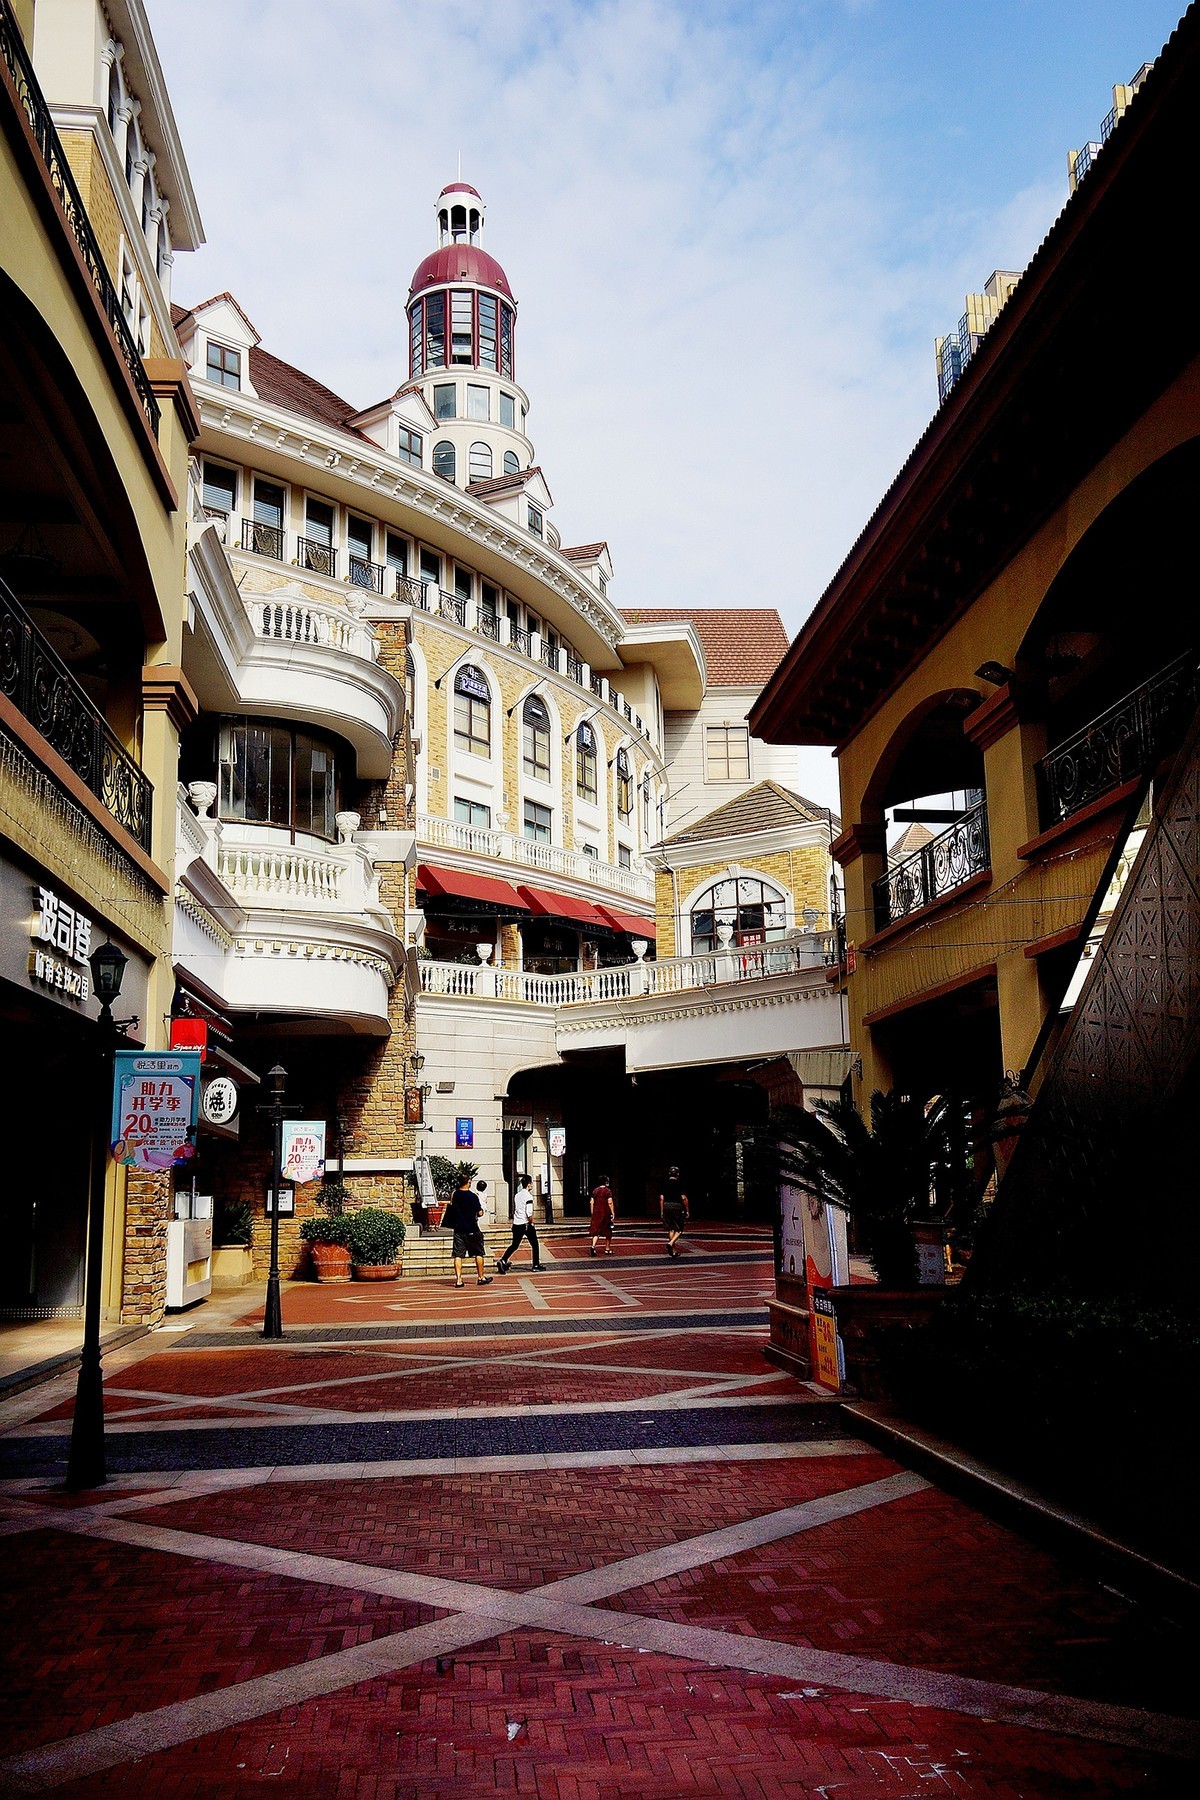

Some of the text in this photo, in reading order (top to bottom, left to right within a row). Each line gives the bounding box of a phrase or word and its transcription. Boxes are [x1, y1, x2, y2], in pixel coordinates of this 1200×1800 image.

[39, 886, 92, 967] 波司登
[141, 1082, 173, 1096] 助力
[132, 1097, 181, 1111] 开学季
